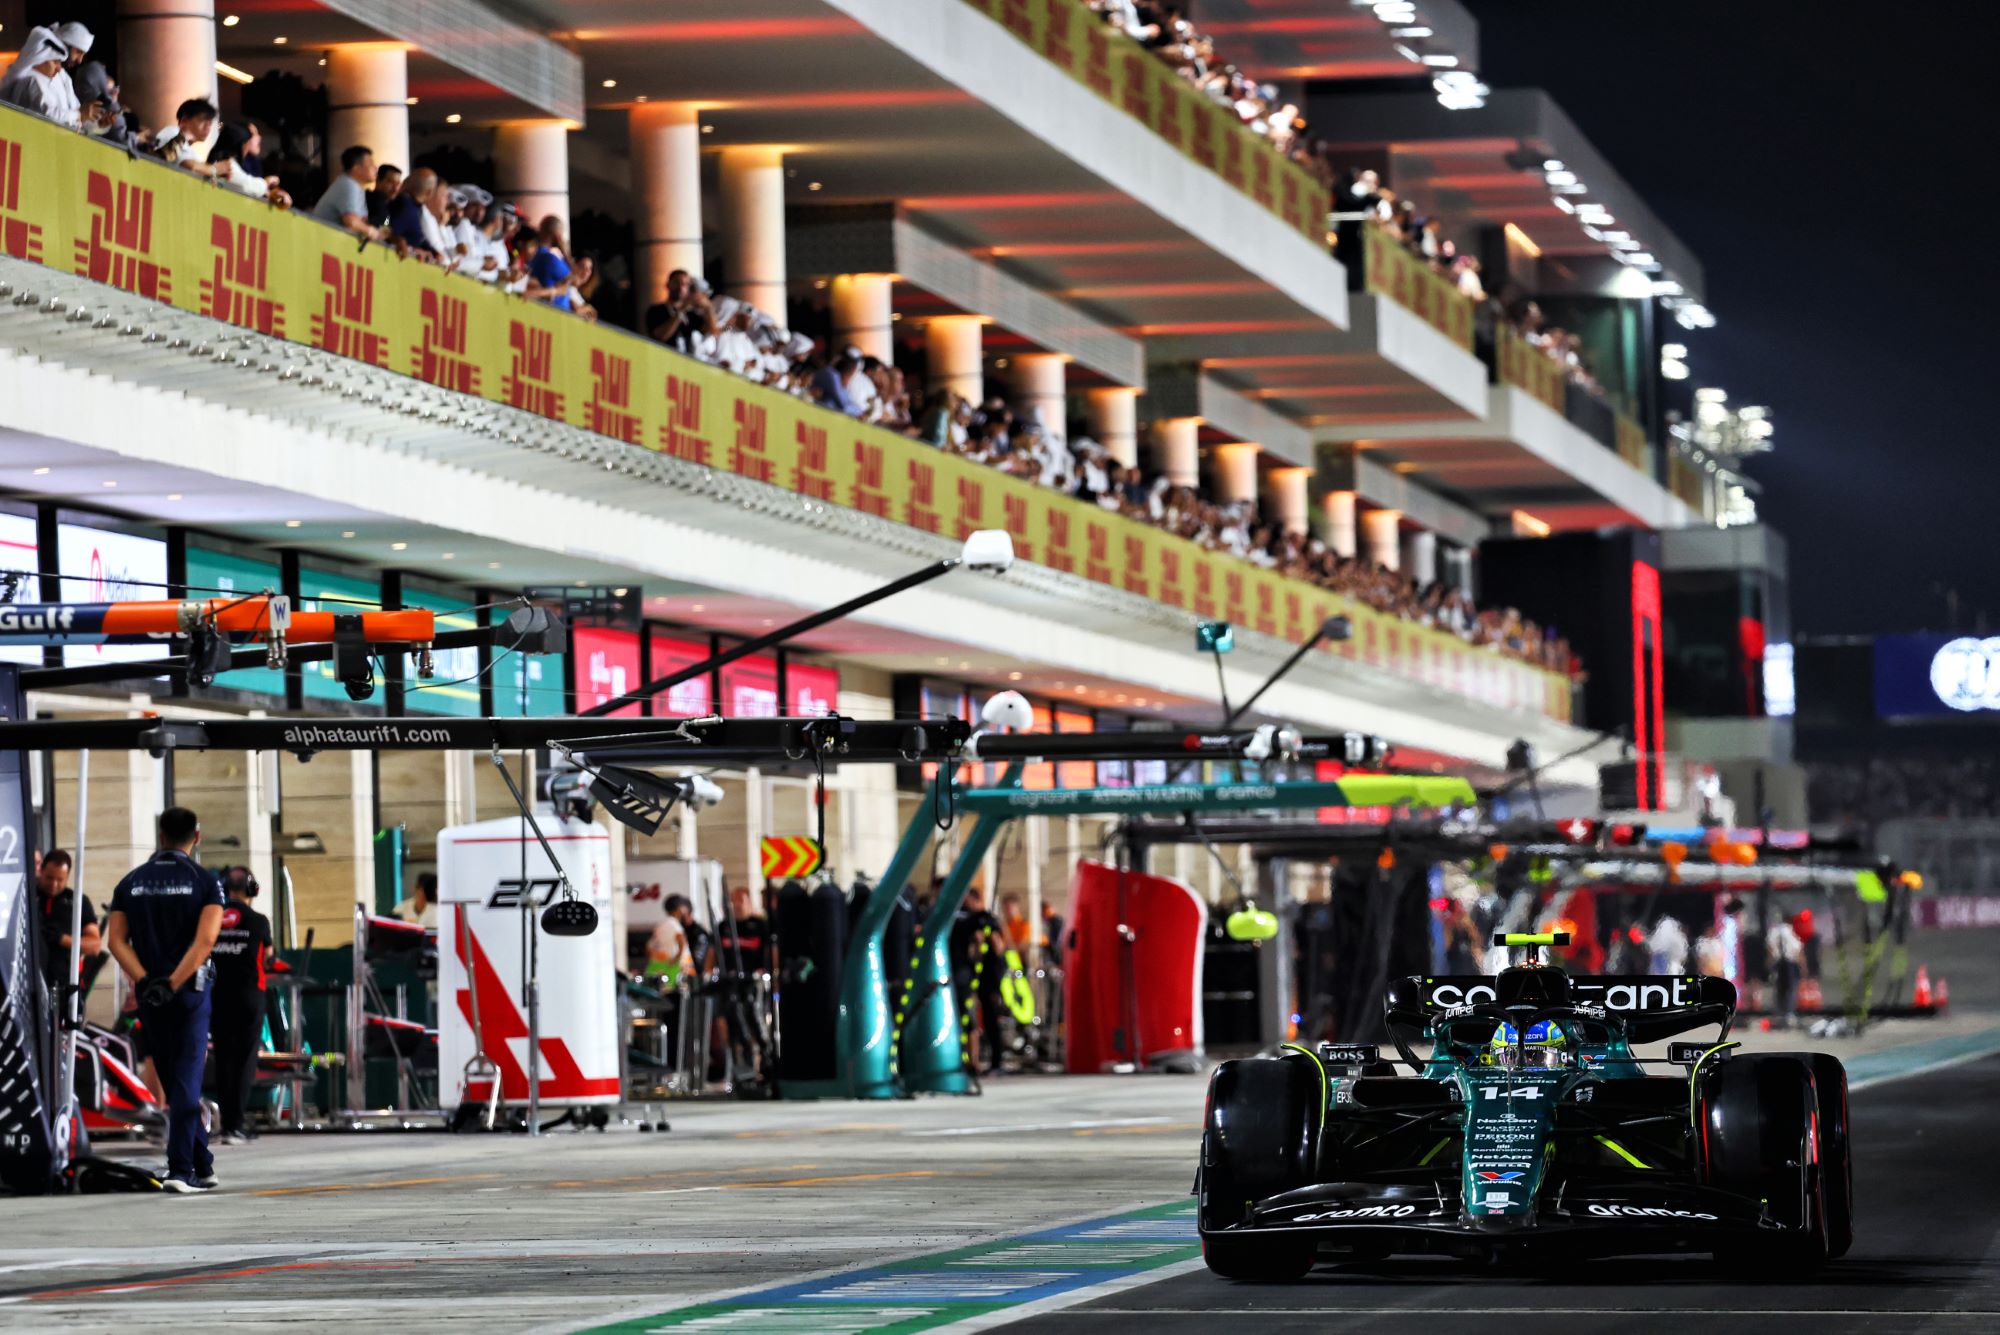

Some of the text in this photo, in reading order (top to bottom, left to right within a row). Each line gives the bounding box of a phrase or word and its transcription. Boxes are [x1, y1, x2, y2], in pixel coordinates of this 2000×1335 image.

[85, 169, 160, 301] DHL
[209, 213, 275, 333] DHL
[319, 252, 380, 365] DHL
[420, 287, 474, 394] DHL
[508, 319, 558, 418] DHL
[0, 605, 76, 633] Gulf
[273, 602, 287, 621] W
[284, 725, 451, 747] alphataurif1.com
[1329, 1050, 1365, 1060] BOSS
[1478, 1086, 1544, 1100] 14
[1292, 1204, 1416, 1222] aramco
[1588, 1204, 1719, 1220] aramco
